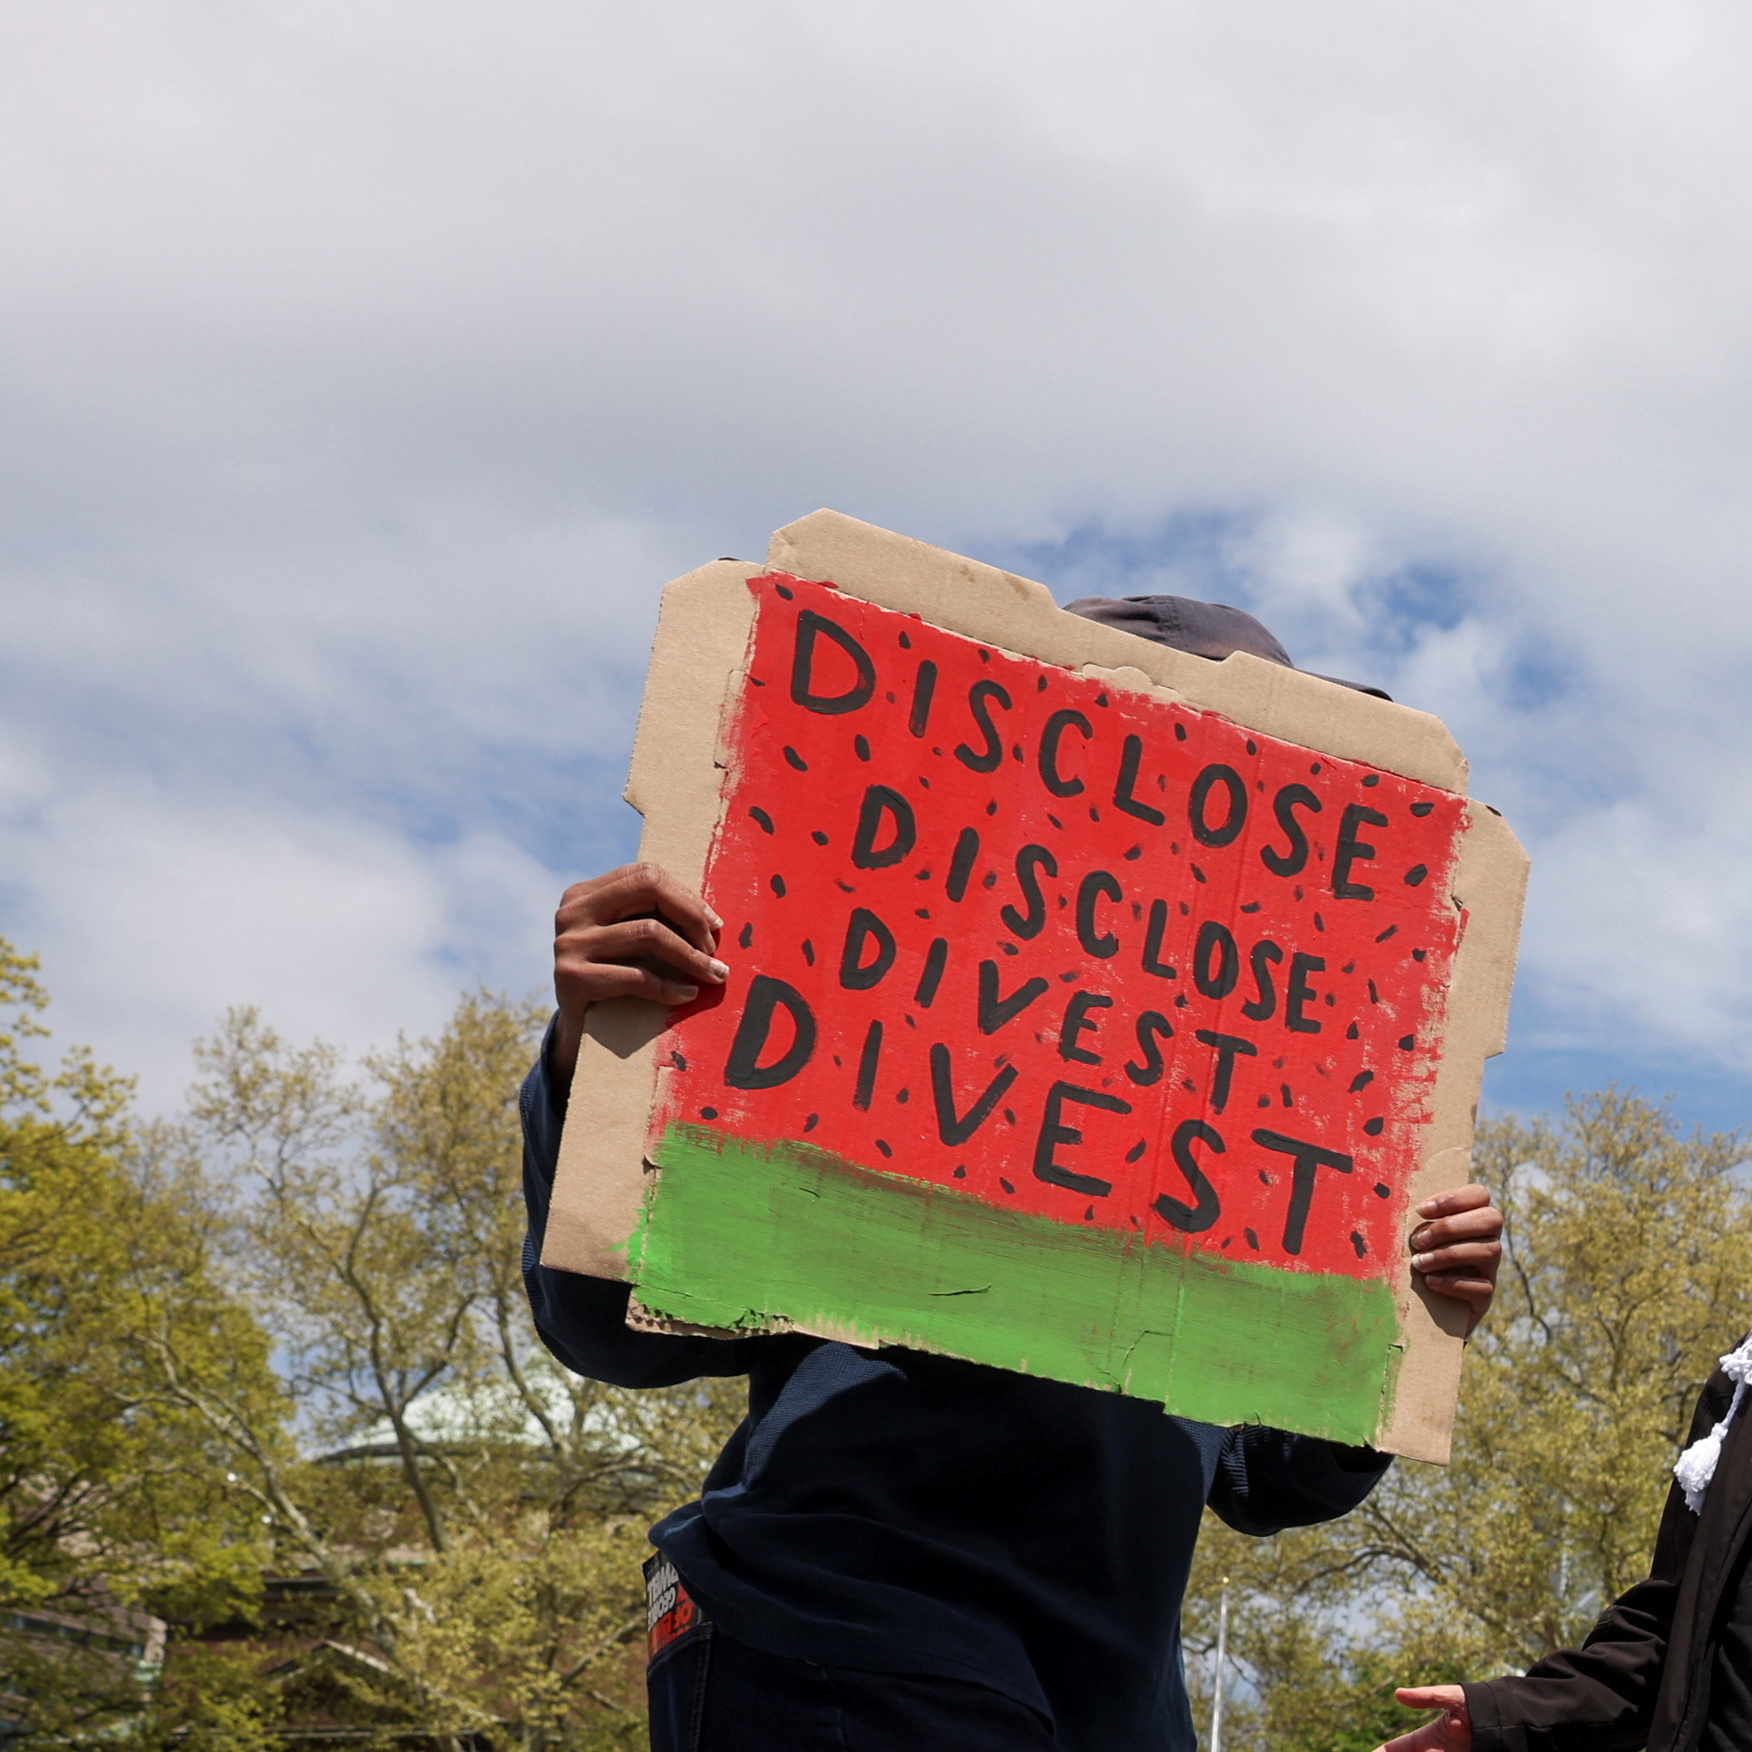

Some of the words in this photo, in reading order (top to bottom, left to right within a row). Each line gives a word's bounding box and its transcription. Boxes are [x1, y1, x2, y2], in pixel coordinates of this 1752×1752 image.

[790, 608, 1389, 900] DISCLOSE
[840, 907, 1258, 1115] DIVEST
[851, 785, 1326, 1035] DISCLOSE
[723, 976, 1353, 1256] DIVEST
